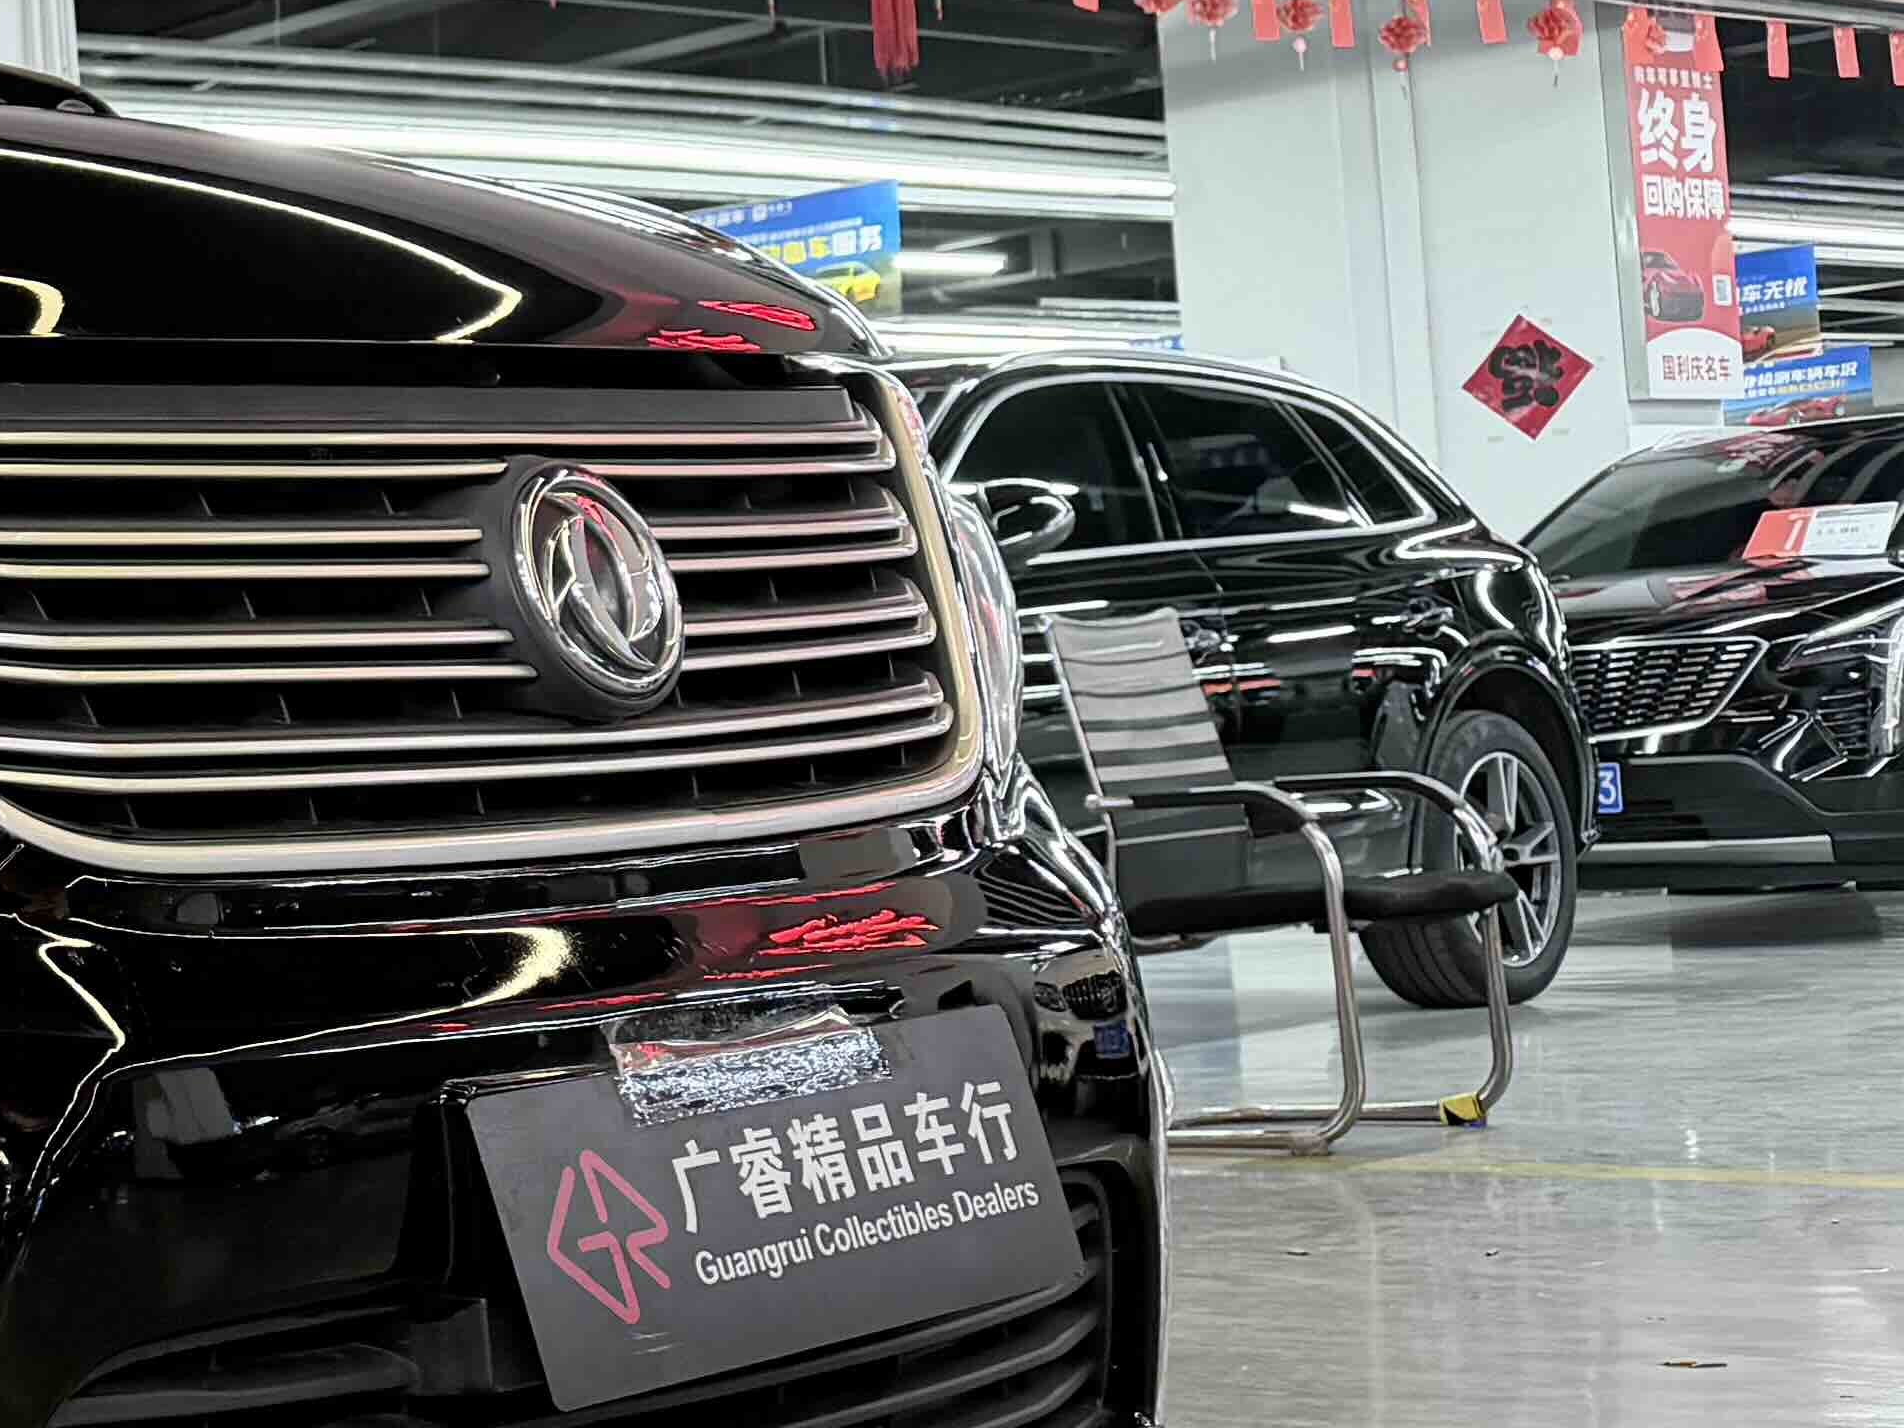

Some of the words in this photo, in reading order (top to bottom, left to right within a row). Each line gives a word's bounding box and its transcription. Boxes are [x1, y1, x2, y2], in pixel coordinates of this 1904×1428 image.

[1637, 87, 1717, 173] 终身
[1644, 176, 1725, 221] 回购保障
[670, 1080, 1019, 1235] 广睿精品车行
[695, 1227, 814, 1286] Guangrui
[814, 1189, 955, 1256] Collectibles
[954, 1178, 1041, 1225] Dealers
